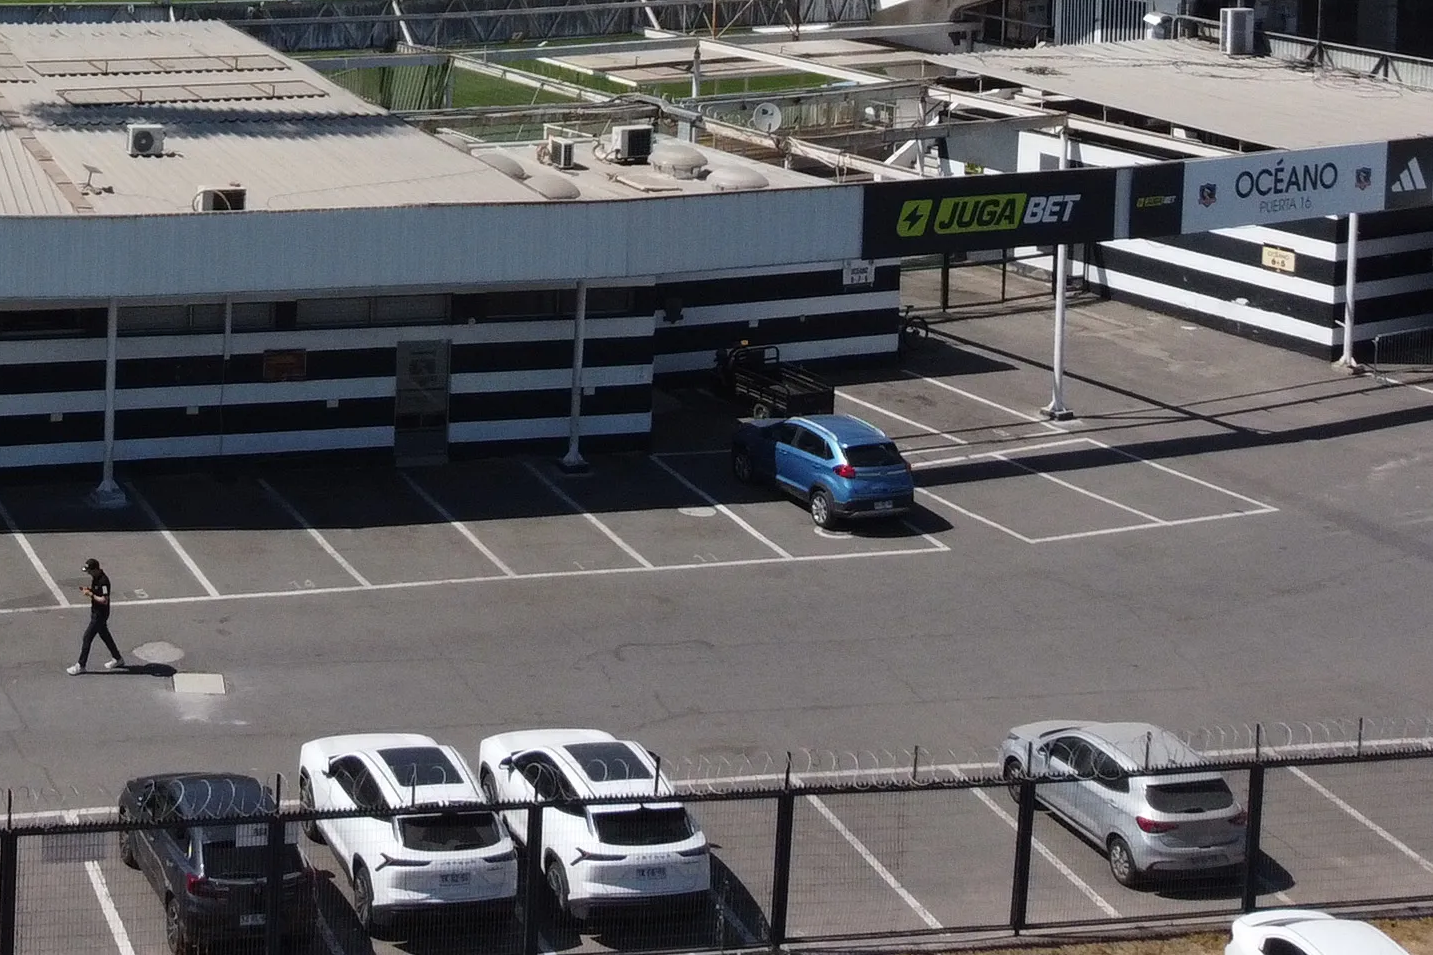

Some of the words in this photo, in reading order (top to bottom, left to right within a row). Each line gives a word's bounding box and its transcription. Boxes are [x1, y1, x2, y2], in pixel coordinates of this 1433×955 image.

[1235, 158, 1338, 199] OCÉANO
[1259, 198, 1297, 214] PUERTA
[1299, 195, 1312, 209] 16
